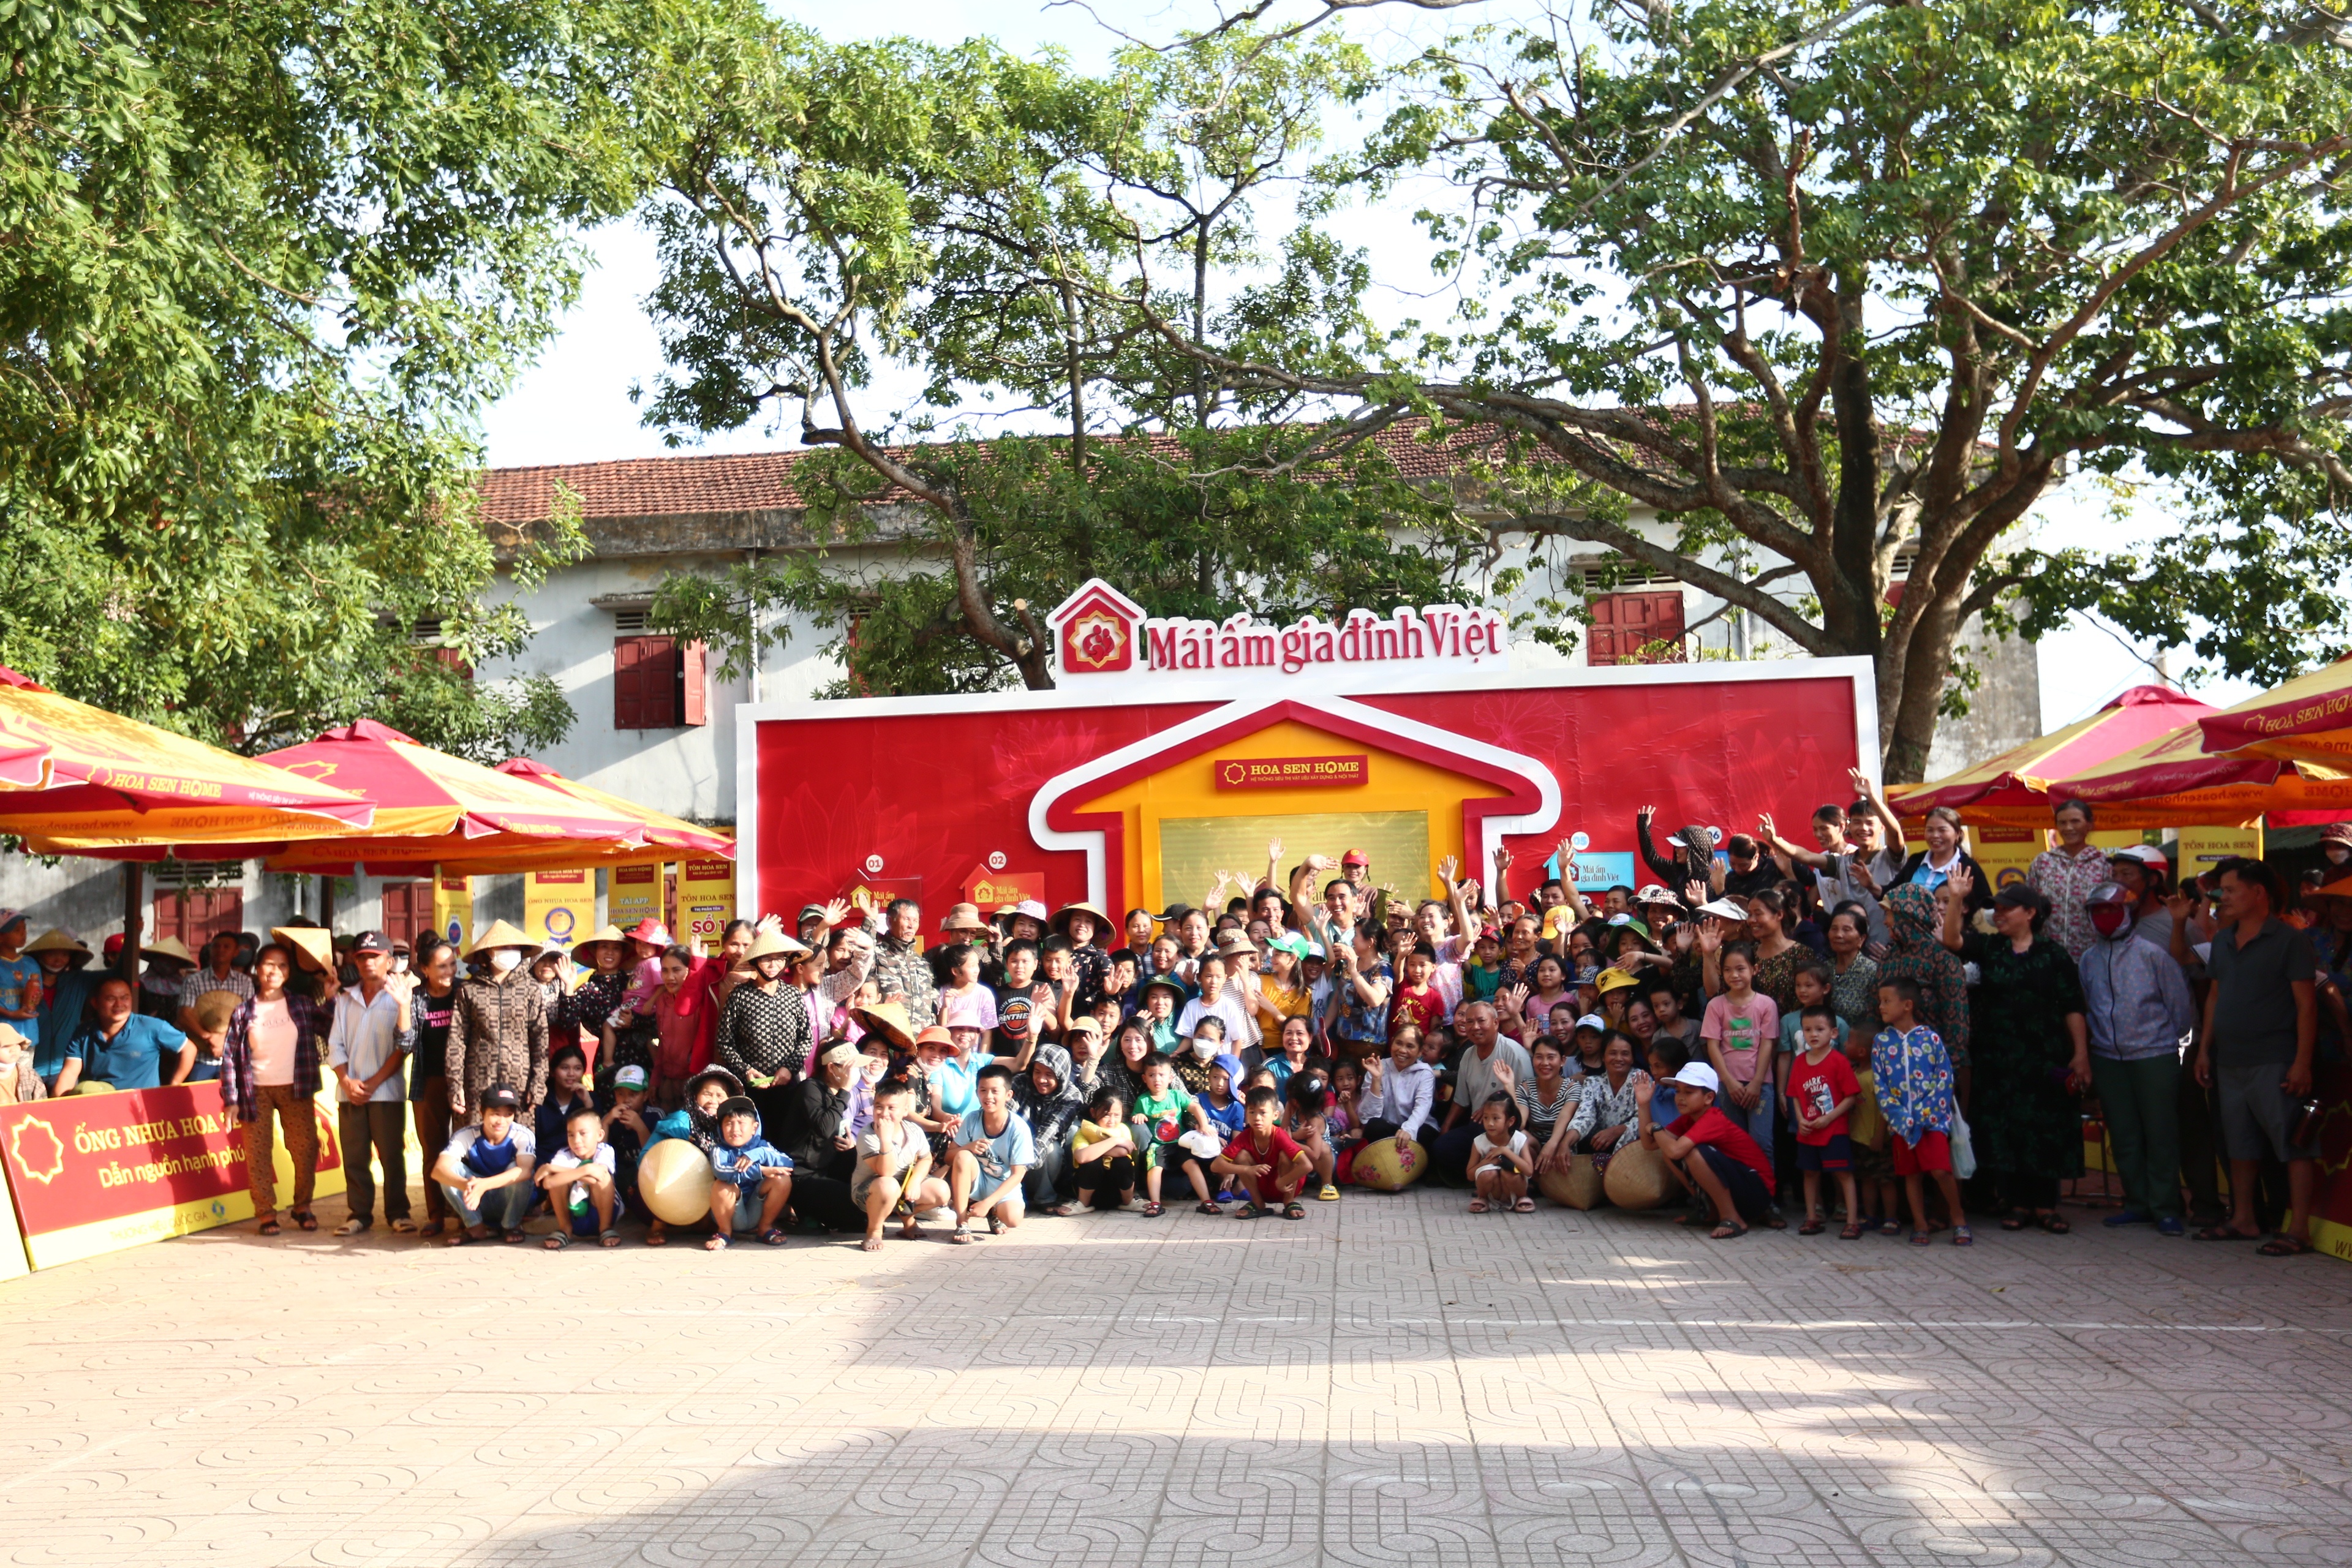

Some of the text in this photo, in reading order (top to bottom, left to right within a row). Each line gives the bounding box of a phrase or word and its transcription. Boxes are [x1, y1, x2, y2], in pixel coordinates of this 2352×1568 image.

[1148, 611, 1502, 673] Mái ấm gia đình Việt
[2266, 714, 2294, 732] HOA
[2296, 703, 2325, 725] SEN
[1250, 761, 1359, 775] HOA SEN HOME
[112, 772, 145, 790] HOA
[148, 776, 179, 794] SEN
[1573, 835, 1586, 846] 05
[2182, 839, 2205, 850] TÔN
[868, 859, 881, 869] 01
[991, 856, 1004, 865] 02
[1581, 873, 1591, 883] gia
[1606, 872, 1619, 882] Việt
[681, 893, 698, 902] TÔN
[995, 894, 1005, 904] gia
[692, 913, 726, 934] SỐ 1
[999, 1012, 1030, 1023] PANTHE
[74, 1121, 121, 1155] ỐNG
[122, 1119, 179, 1147] NHỰA
[179, 1114, 221, 1137] HOA
[97, 1144, 247, 1189] Dẫn nguồn hạnh phú
[194, 1210, 209, 1223] GIA
